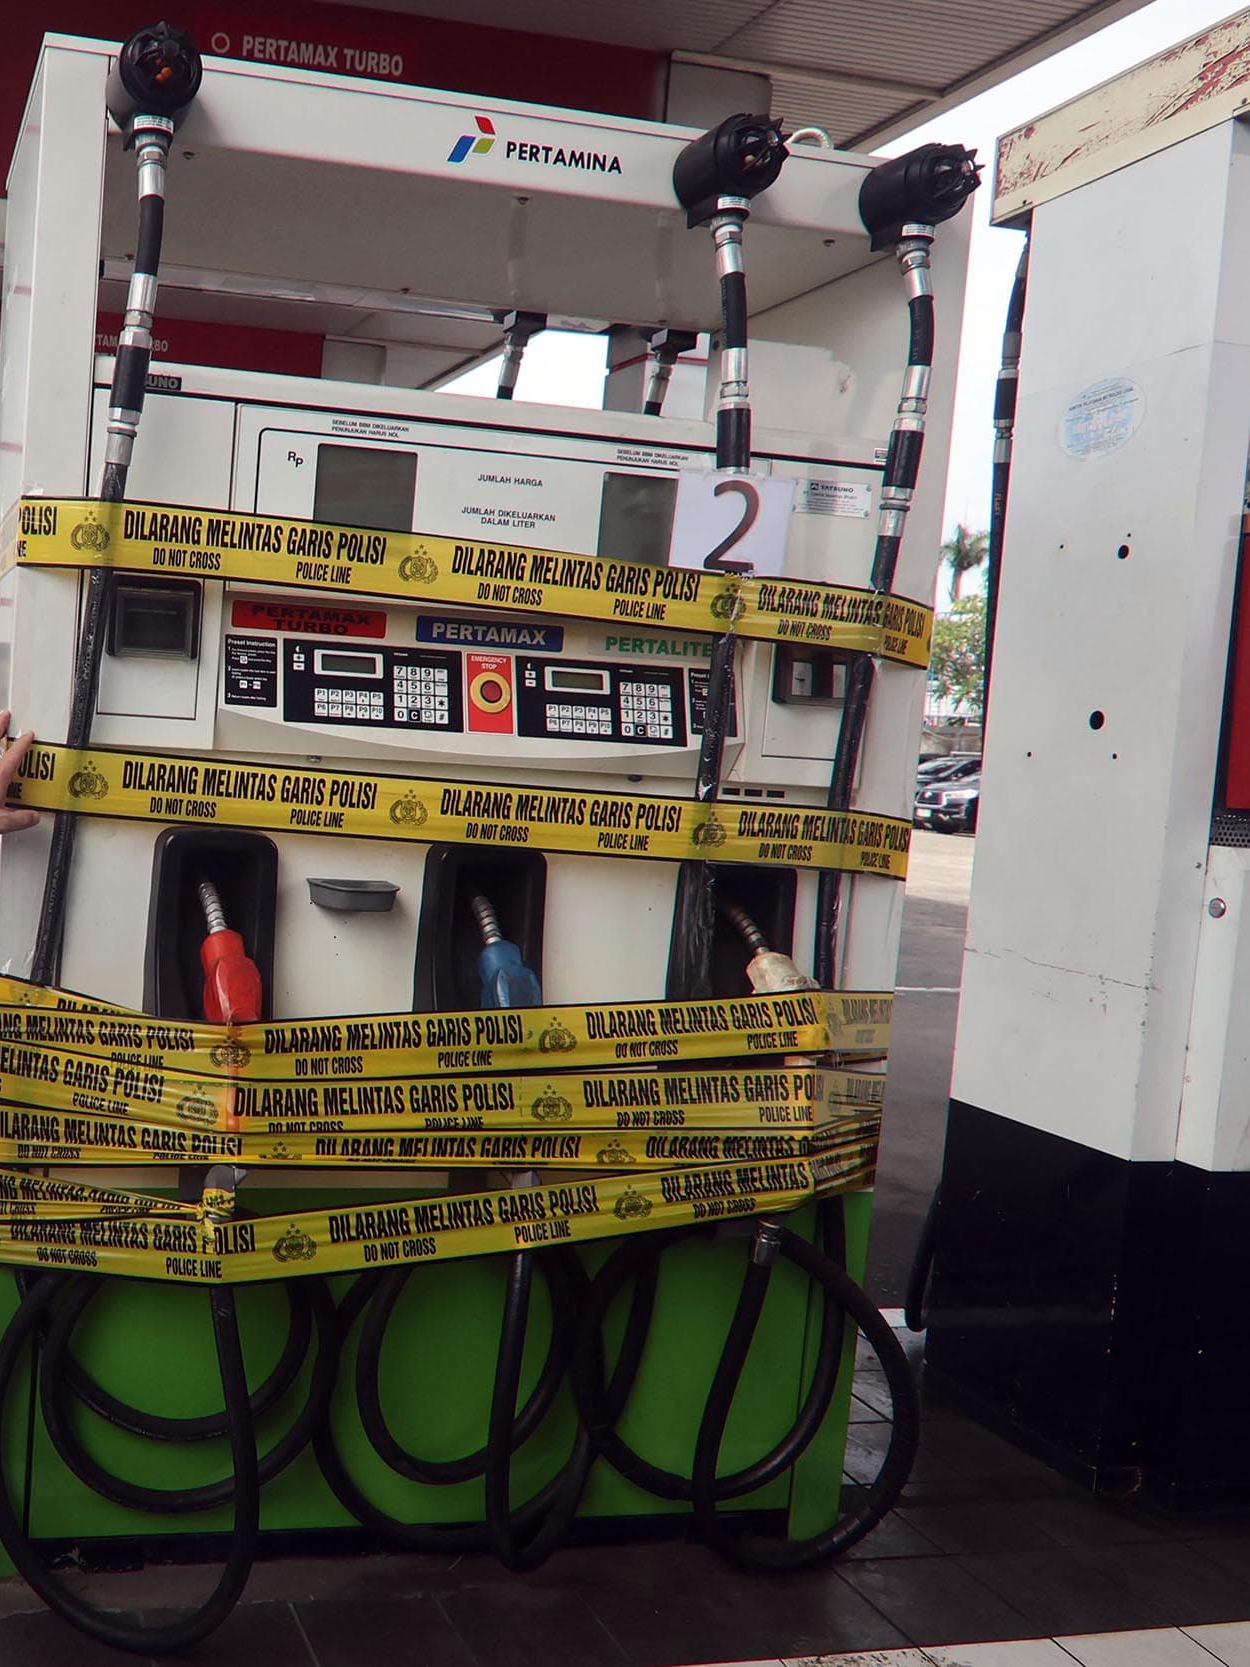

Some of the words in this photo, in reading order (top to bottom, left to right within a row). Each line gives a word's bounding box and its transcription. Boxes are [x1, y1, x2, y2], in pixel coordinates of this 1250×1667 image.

[242, 34, 338, 68] PERTAMAX
[344, 49, 403, 77] TURBO
[505, 141, 623, 175] PERTAMINA
[477, 473, 511, 484] JUMLAH
[514, 477, 543, 487] HARGA
[462, 506, 495, 517] JUMLAH
[497, 509, 556, 521] DIKELUARKAN
[481, 516, 510, 527] DALAM
[513, 519, 536, 529] LITER
[124, 509, 201, 545] DILARANG
[206, 521, 283, 553] MELINTAS
[286, 531, 333, 560] GARIS
[336, 537, 388, 565] POLISI
[704, 480, 759, 572] 2
[153, 547, 166, 566] DO
[168, 549, 188, 568] NOT
[189, 551, 221, 570] CROSS
[296, 561, 328, 582] POLICE
[330, 564, 352, 585] LINE
[451, 545, 527, 582] DILARANG
[531, 556, 601, 591] MELINTAS
[606, 565, 650, 597] GARIS
[653, 572, 701, 602] POLISI
[477, 582, 491, 599] DO
[492, 584, 511, 602] NOT
[512, 587, 543, 606] CROSS
[252, 604, 372, 626] PERTAMAX
[613, 599, 644, 618] POLICE
[646, 602, 667, 620] LINE
[758, 583, 821, 617] DILARANG
[821, 593, 883, 625] MELINTAS
[904, 607, 926, 638] POLISI
[273, 617, 348, 636] TURBO
[431, 622, 547, 646] PERTAMAX
[777, 618, 790, 636] DO
[790, 620, 807, 638] NOT
[807, 622, 833, 641] CROSS
[605, 635, 712, 657] PERTALITE
[471, 655, 507, 664] EMERGENCY
[482, 662, 498, 670] STOP
[396, 666, 403, 674] 7
[410, 668, 417, 676] 8
[424, 669, 431, 677] 9
[411, 696, 418, 704] 2
[17, 750, 56, 781] OLISI
[122, 760, 198, 795] DILARANG
[201, 767, 277, 801] MELINTAS
[280, 775, 326, 805] GARIS
[329, 780, 378, 810] POLISI
[149, 797, 163, 814] DO
[165, 798, 183, 816] NOT
[184, 800, 217, 818] CROSS
[289, 808, 322, 827] POLICE
[323, 811, 345, 828] LINE
[440, 788, 511, 821] DILARANG
[515, 793, 585, 825] MELINTAS
[589, 800, 632, 829] GARIS
[634, 805, 682, 833] POLISI
[465, 822, 479, 839] DO
[480, 824, 498, 841] NOT
[499, 825, 530, 842] CROSS
[597, 832, 628, 850] POLICE
[629, 834, 650, 851] LINE
[737, 810, 800, 839] DILARANG
[801, 814, 857, 845] MELINTAS
[857, 820, 883, 848] GARIS
[883, 824, 912, 853] POLISI
[758, 842, 770, 858] DO
[770, 843, 786, 859] NOT
[787, 845, 813, 861] CROSS
[585, 1009, 657, 1039] DILARANG
[659, 1004, 728, 1035] MELINTAS
[730, 1002, 773, 1031] GARIS
[774, 997, 819, 1028] POLISI
[26, 1015, 95, 1044] MELINTAS
[98, 1022, 143, 1048] GARIS
[146, 1026, 195, 1051] POLISI
[265, 1022, 342, 1054] DILARANG
[346, 1019, 422, 1050] MELINTAS
[426, 1016, 471, 1048] GARIS
[475, 1014, 523, 1045] POLISI
[747, 1032, 777, 1050] POLICE
[778, 1031, 798, 1049] LINE
[438, 1052, 470, 1068] POLICE
[472, 1050, 492, 1067] LINE
[615, 1042, 628, 1058] DO
[629, 1041, 647, 1058] NOT
[648, 1039, 678, 1056] CROSS
[295, 1058, 309, 1076] DO
[310, 1057, 329, 1075] NOT
[331, 1056, 363, 1074] CROSS
[62, 1058, 109, 1093] GARIS
[112, 1067, 165, 1103] POLISI
[583, 1078, 661, 1108] DILARANG
[663, 1076, 740, 1106] MELINTAS
[743, 1075, 789, 1102] GARIS
[73, 1092, 105, 1111] POLICE
[107, 1100, 130, 1114] LINE
[233, 1086, 318, 1117] DILARANG
[324, 1085, 405, 1116] MELINTAS
[409, 1083, 458, 1113] GARIS
[462, 1082, 515, 1111] POLISI
[616, 1111, 630, 1127] DO
[632, 1110, 650, 1126] NOT
[653, 1109, 685, 1126] CROSS
[759, 1106, 791, 1123] POLICE
[793, 1105, 813, 1122] LINE
[64, 1119, 137, 1148] MELINTAS
[661, 1169, 735, 1203] DILARANG
[737, 1160, 810, 1194] MELINTAS
[328, 1207, 411, 1243] DILARANG
[414, 1198, 494, 1235] MELINTAS
[497, 1192, 545, 1223] GARIS
[548, 1185, 600, 1216] POLISI
[693, 1202, 706, 1219] DO
[707, 1200, 725, 1217] NOT
[726, 1197, 757, 1215] CROSS
[80, 1222, 148, 1249] MELINTAS
[153, 1224, 197, 1254] GARIS
[514, 1223, 548, 1244] POLICE
[549, 1220, 572, 1239] LINE
[37, 1247, 49, 1262] DO
[50, 1248, 68, 1264] NOT
[69, 1249, 97, 1267] CROSS
[363, 1244, 377, 1263] DO
[380, 1241, 400, 1261] NOT
[402, 1237, 436, 1258] CROSS
[166, 1257, 198, 1276] POLICE
[200, 1260, 222, 1278] LINE
